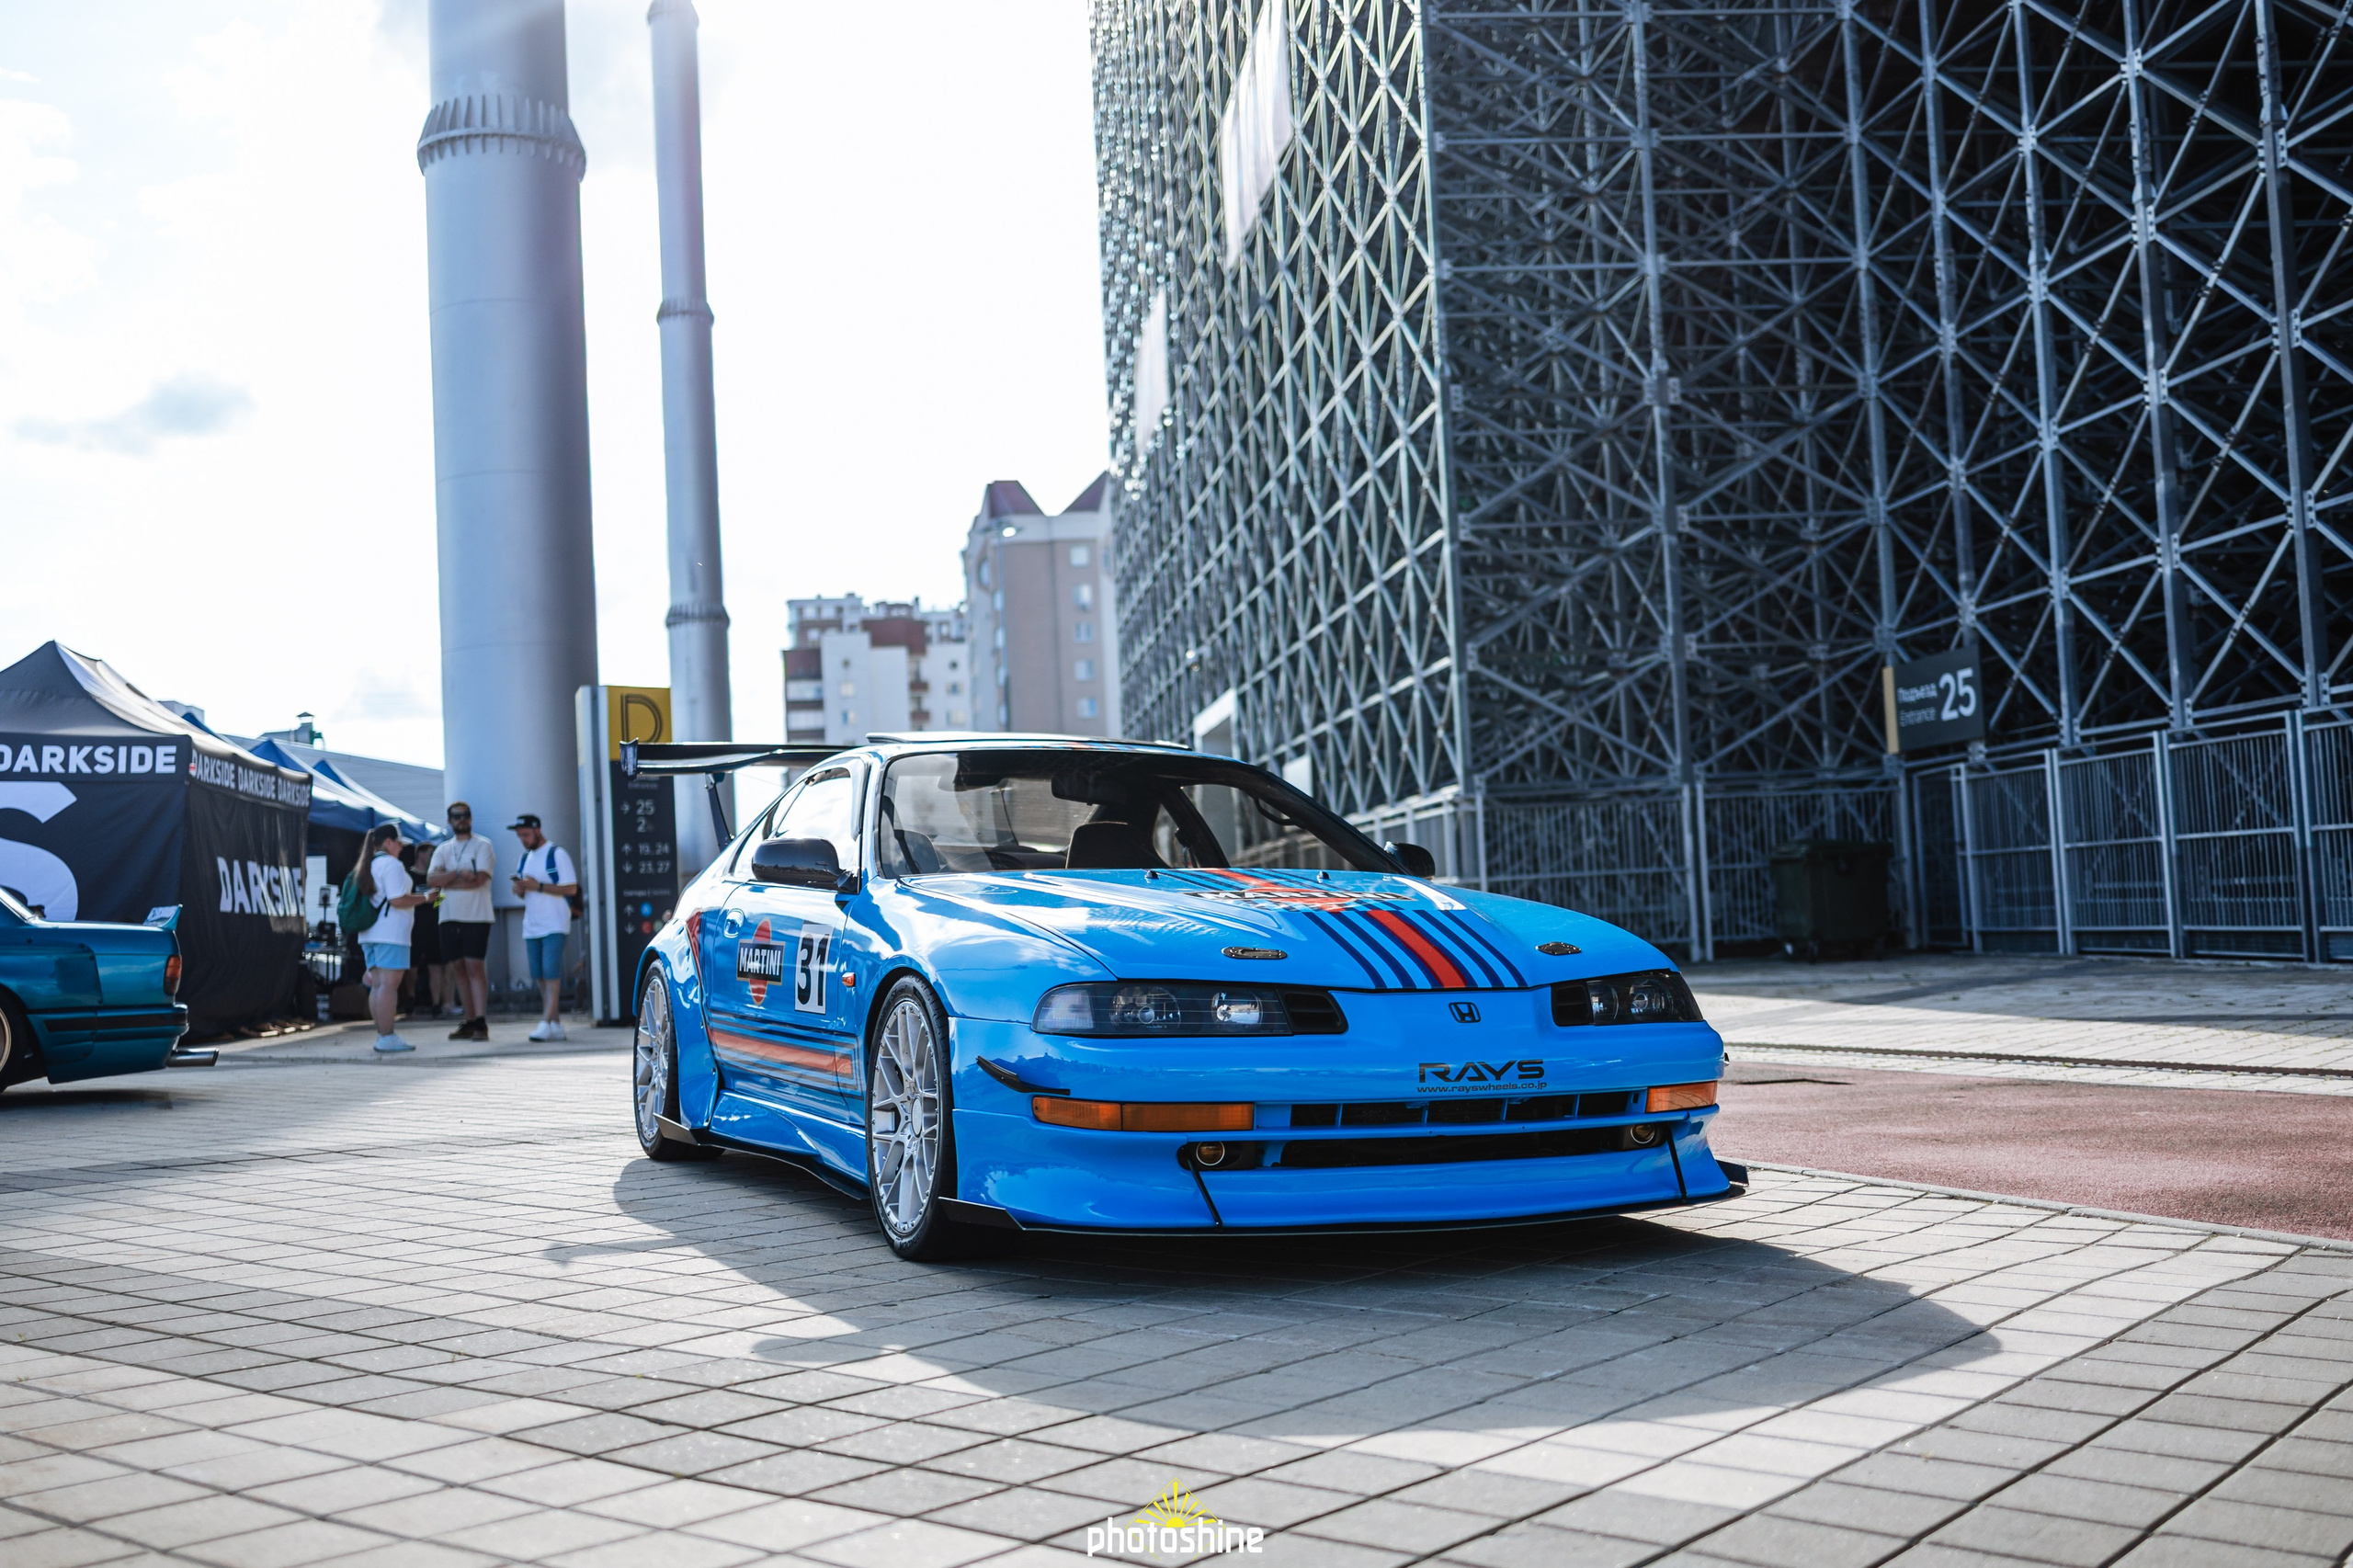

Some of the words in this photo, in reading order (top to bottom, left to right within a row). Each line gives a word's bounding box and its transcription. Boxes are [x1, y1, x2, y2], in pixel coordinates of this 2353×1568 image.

[1938, 667, 1977, 721] 25
[620, 693, 664, 743] D
[1899, 707, 1937, 727] Entrance
[0, 744, 176, 774] DARKSIDE
[191, 748, 235, 790] DARKSIDE
[237, 766, 277, 800] DARKSIDE
[278, 777, 311, 808] DARKSIDE
[636, 799, 655, 815] 25
[217, 856, 305, 917] DARKSIDE
[1197, 892, 1400, 900] MARTINI
[739, 948, 781, 976] MARTINI
[797, 933, 830, 1007] 31
[1418, 1059, 1545, 1083] RAYS
[1416, 1080, 1548, 1094] www.rayswheels.co.jp
